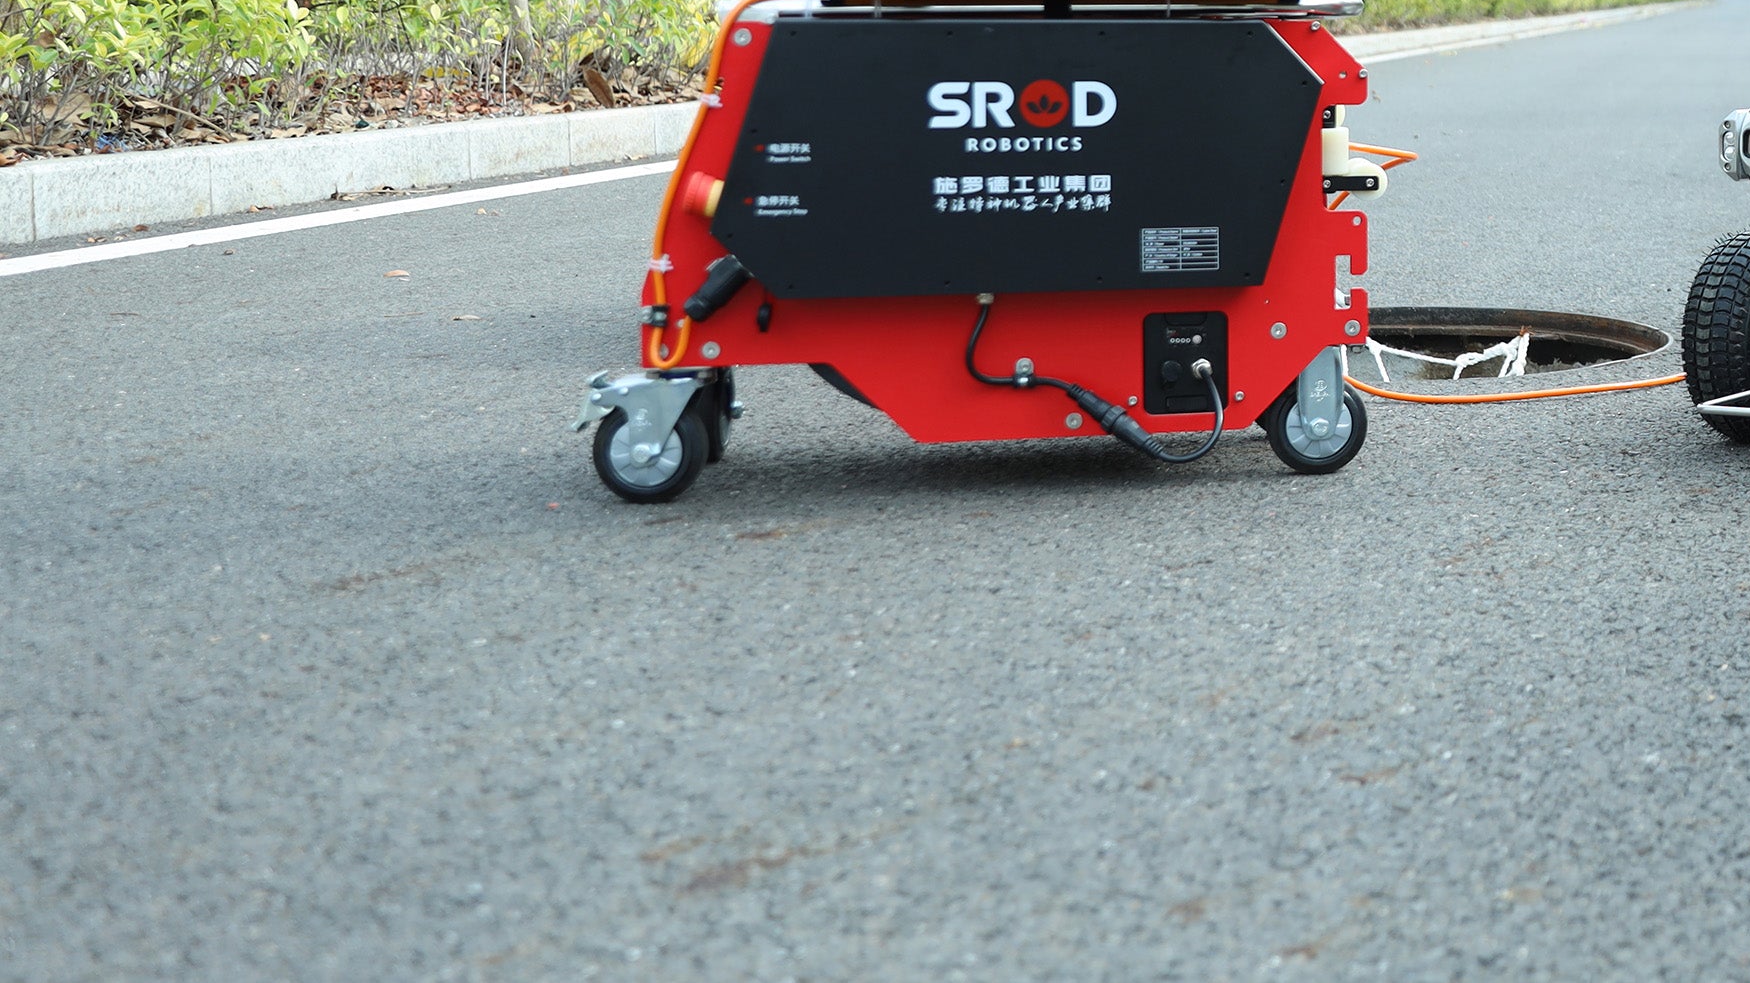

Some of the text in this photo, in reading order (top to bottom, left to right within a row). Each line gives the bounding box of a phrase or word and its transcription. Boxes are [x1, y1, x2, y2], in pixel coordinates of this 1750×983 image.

[965, 137, 1083, 153] ROBOTICS
[933, 175, 1112, 195] 施罗德工业集团
